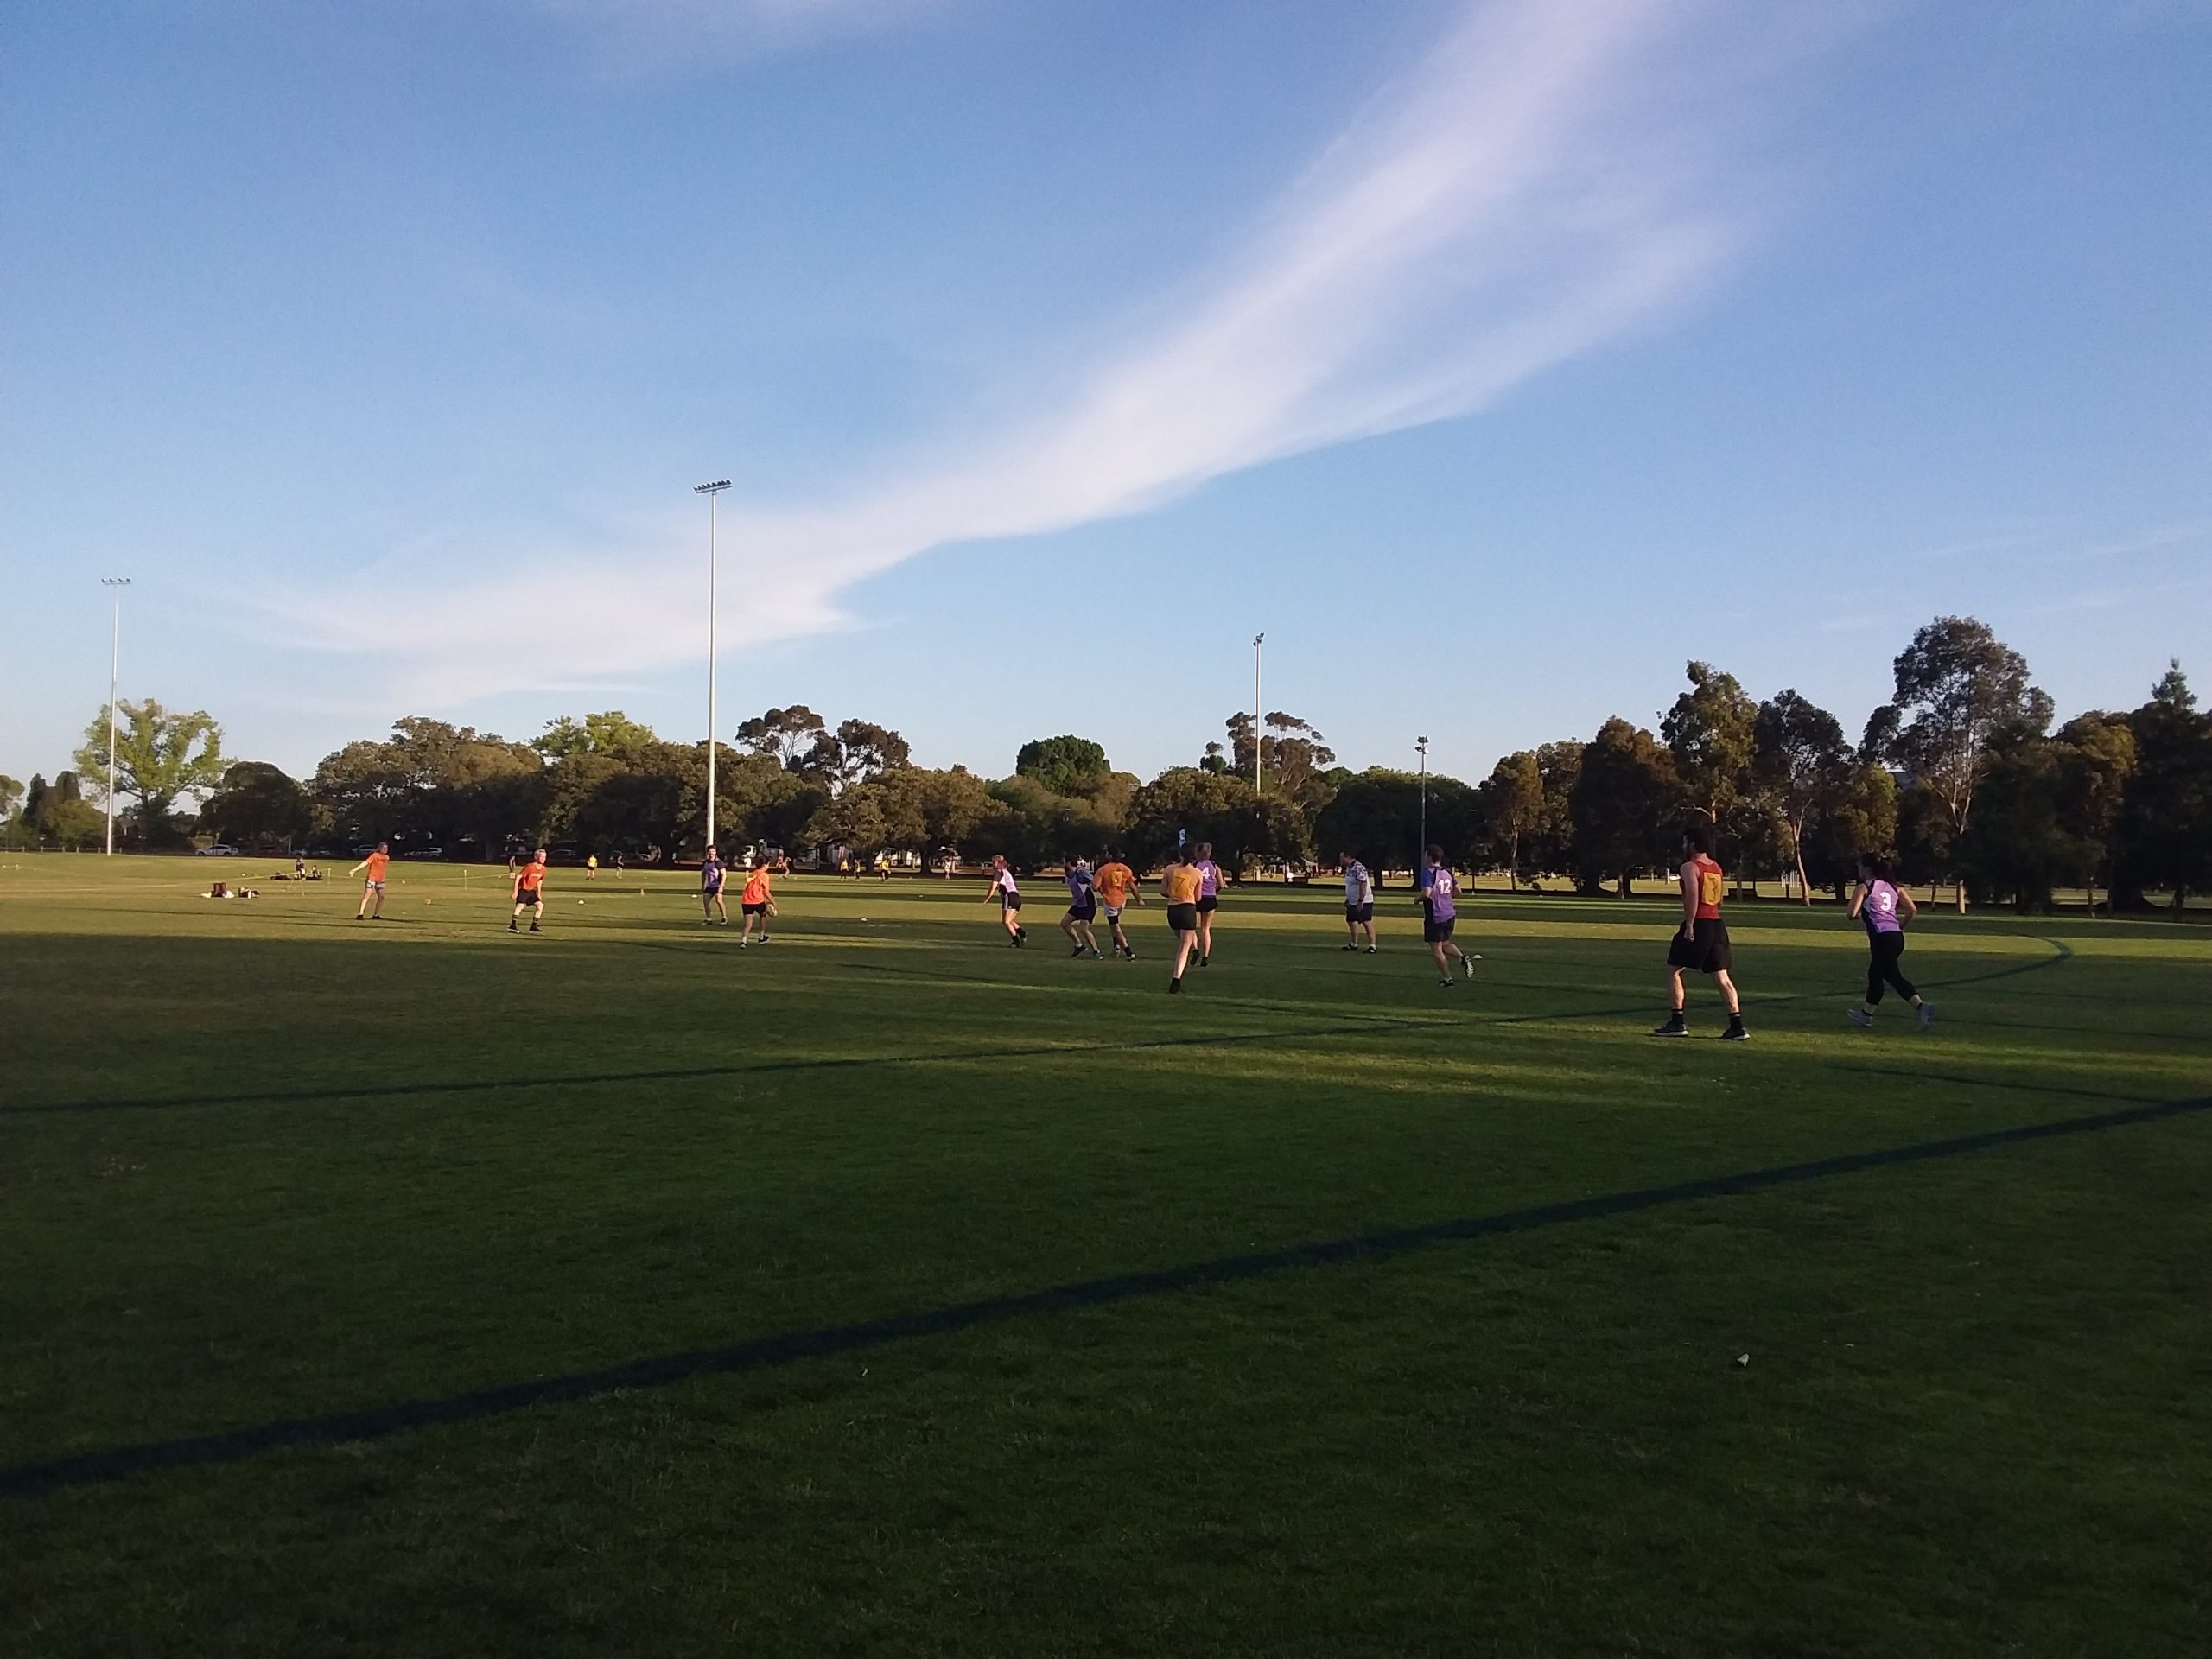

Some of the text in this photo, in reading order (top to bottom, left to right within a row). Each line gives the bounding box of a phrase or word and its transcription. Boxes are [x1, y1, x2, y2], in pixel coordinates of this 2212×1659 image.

[1202, 867, 1210, 879] 4
[1175, 876, 1185, 892] 7
[1438, 879, 1451, 894] 12
[1880, 892, 1891, 911] 3
